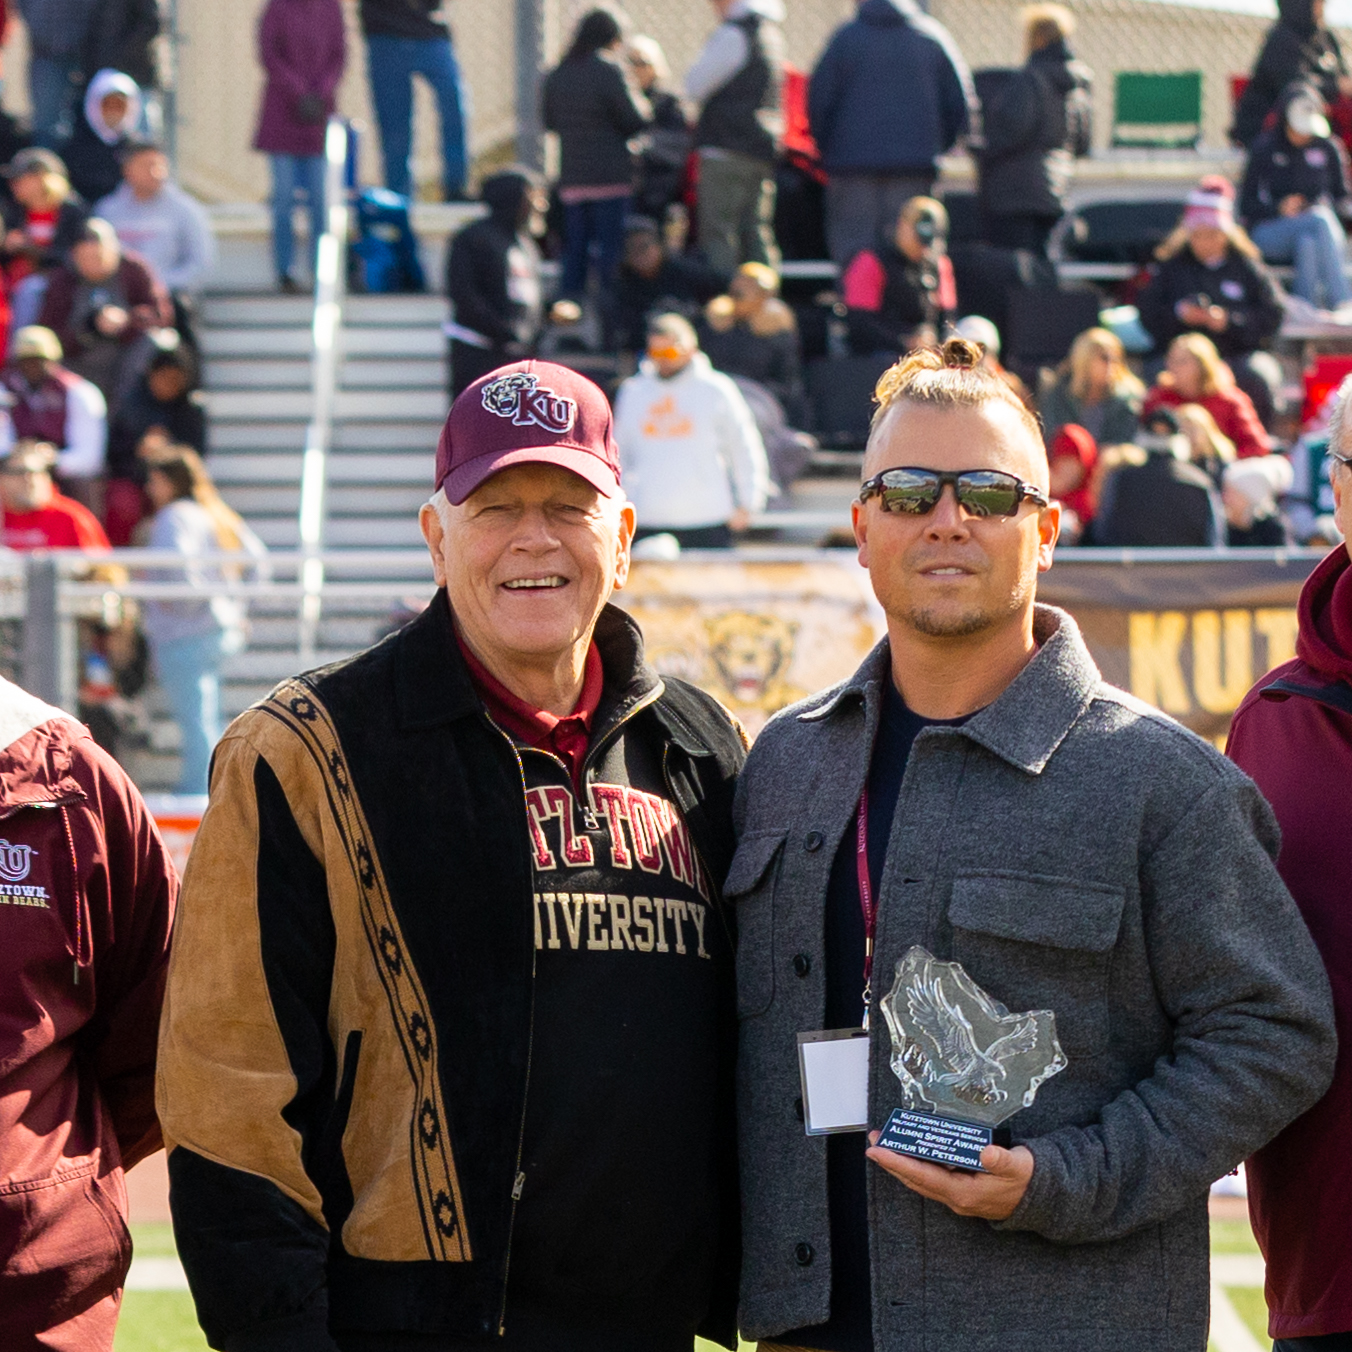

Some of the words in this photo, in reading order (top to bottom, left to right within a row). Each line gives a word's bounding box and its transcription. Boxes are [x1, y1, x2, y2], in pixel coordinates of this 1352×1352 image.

[513, 387, 578, 434] KU
[12, 895, 46, 908] BEARS
[889, 1125, 924, 1140] ALUMNI
[924, 1132, 953, 1147] SPIRIT
[900, 1112, 940, 1127] KUTZTOWN
[940, 1120, 983, 1136] UNIVERSITY
[880, 1138, 917, 1153] ARTHUR
[917, 1145, 930, 1157] W.
[931, 1148, 978, 1167] PETERSON
